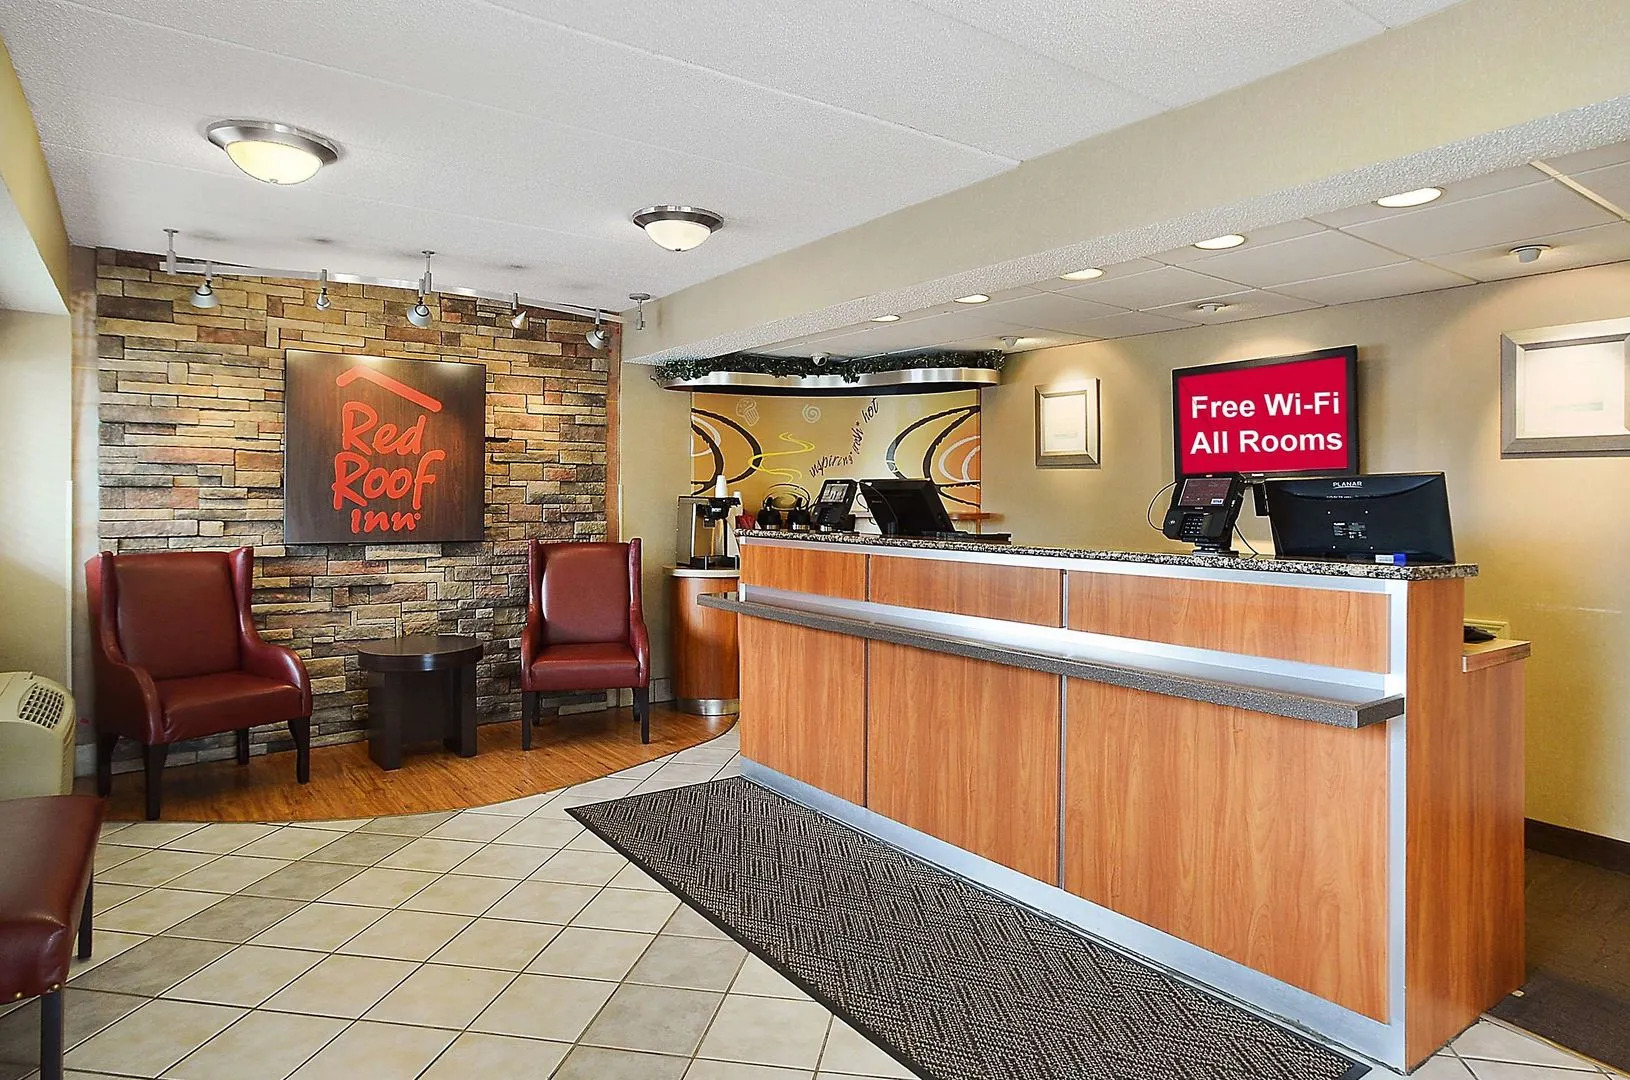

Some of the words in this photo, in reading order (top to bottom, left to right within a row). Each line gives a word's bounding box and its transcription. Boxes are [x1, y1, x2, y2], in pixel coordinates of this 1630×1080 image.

[1191, 395, 1255, 419] Free
[1264, 391, 1340, 416] Wi-Fi
[341, 401, 427, 456] Red
[1190, 431, 1228, 455] All
[1239, 430, 1343, 453] Rooms
[331, 449, 446, 511] Roof
[1332, 480, 1363, 488] PLANAR
